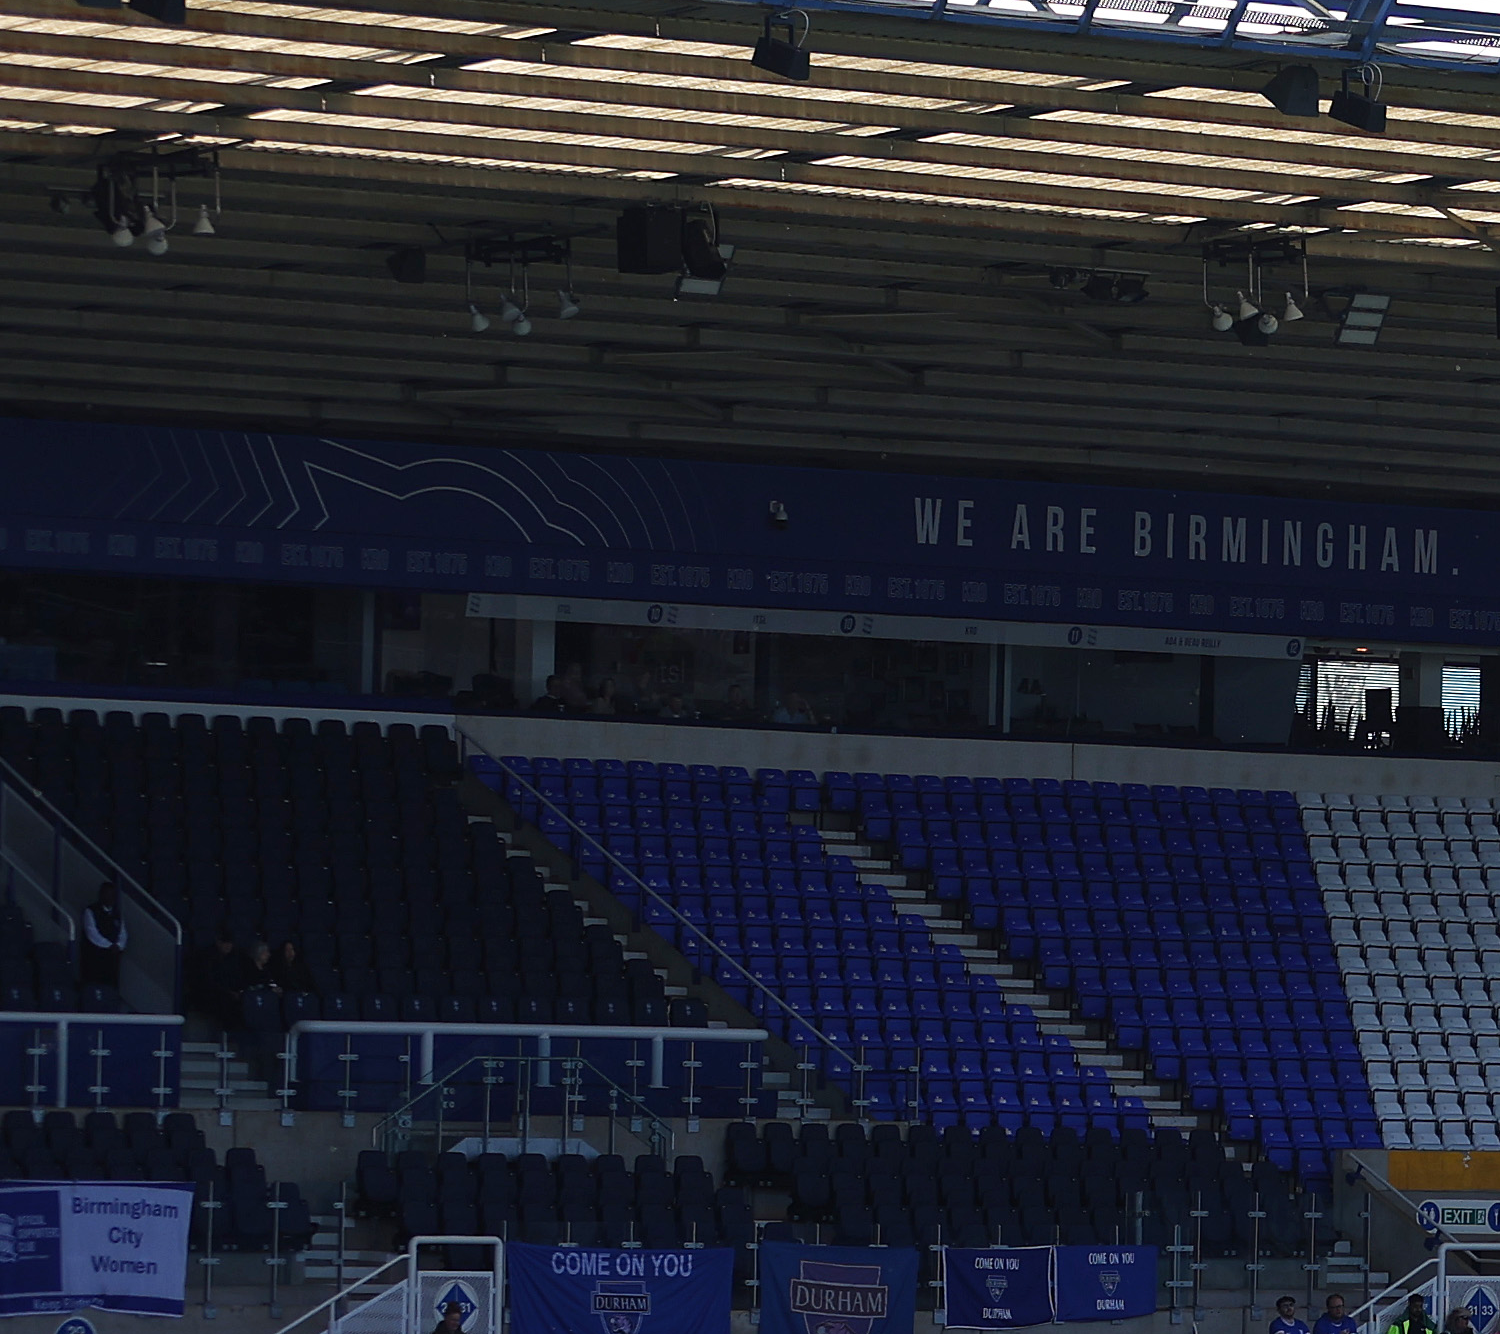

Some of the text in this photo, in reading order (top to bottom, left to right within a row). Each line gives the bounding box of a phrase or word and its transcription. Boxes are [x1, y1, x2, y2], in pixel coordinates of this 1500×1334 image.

[914, 497, 974, 547] WE
[1011, 504, 1096, 554] ARE
[72, 1197, 178, 1219] Birmingham
[1444, 1210, 1472, 1224] EXIT
[109, 1227, 144, 1248] City
[92, 1256, 157, 1274] Women
[552, 1252, 693, 1277] COME ON YOU
[975, 1257, 1019, 1271] COME ON YOU
[1088, 1252, 1134, 1265] COME ON YOU
[595, 1295, 647, 1310] DURHAM
[796, 1285, 883, 1314] DURHAM
[1481, 1305, 1494, 1315] 33
